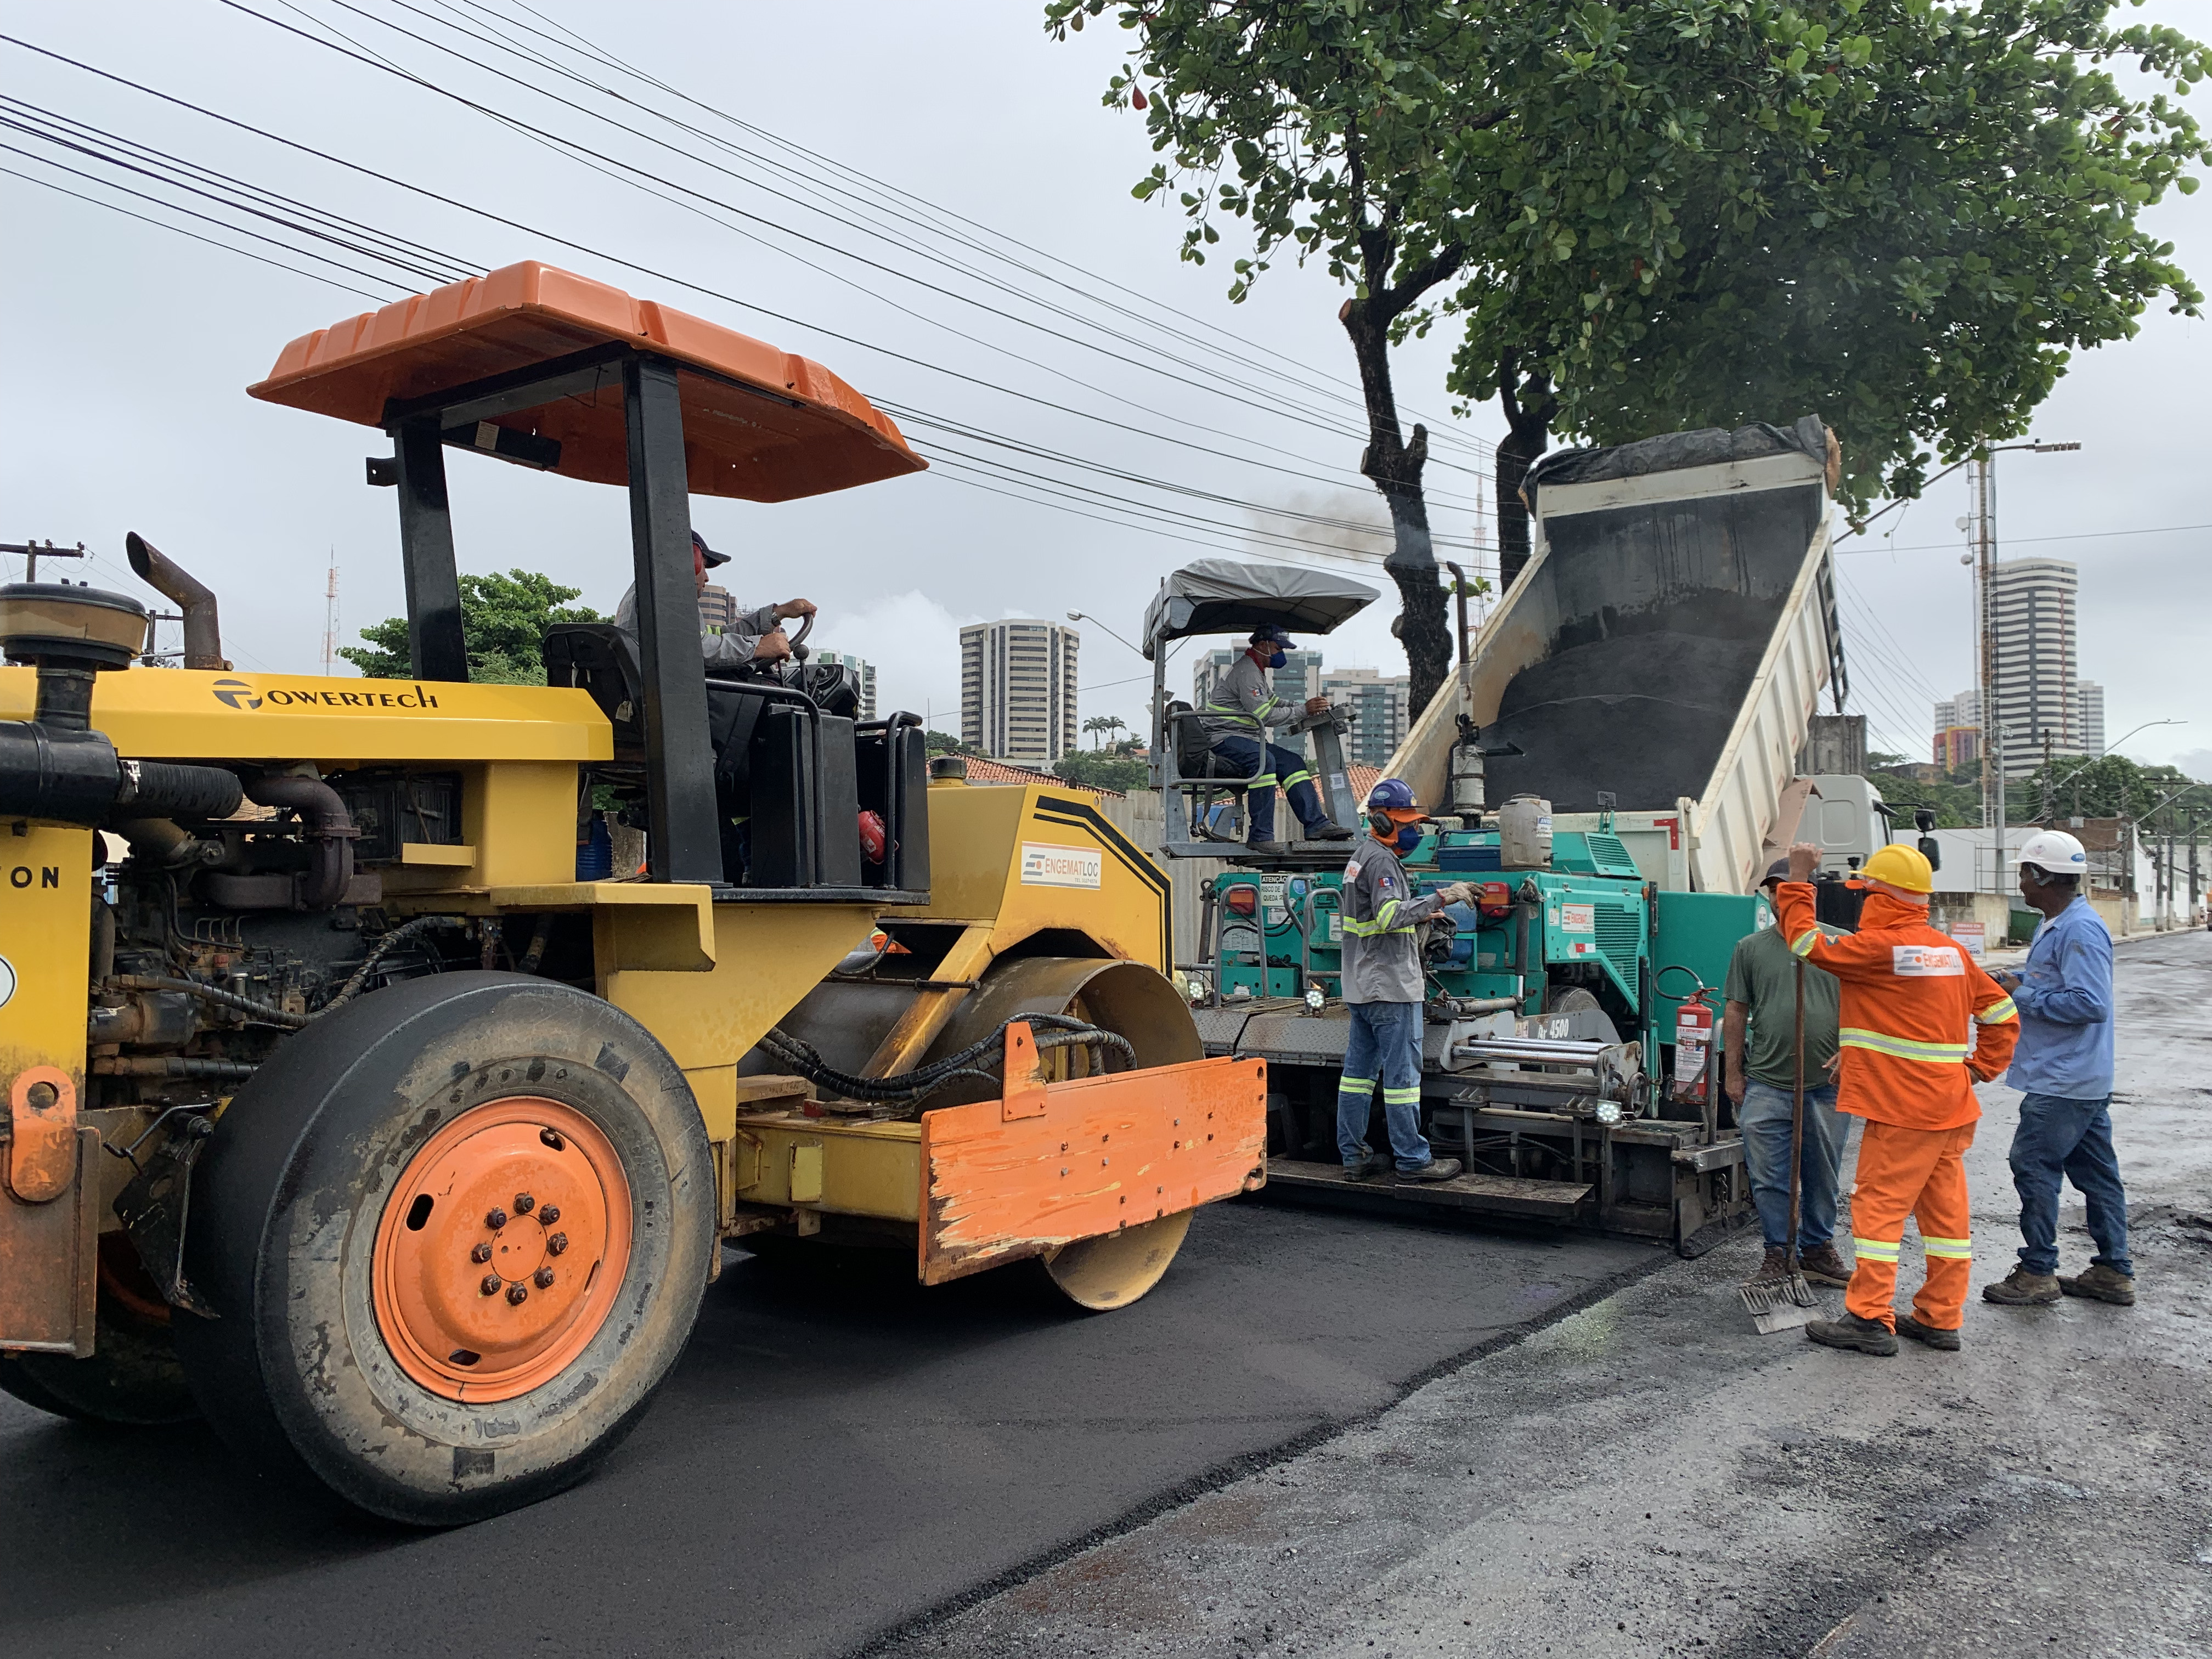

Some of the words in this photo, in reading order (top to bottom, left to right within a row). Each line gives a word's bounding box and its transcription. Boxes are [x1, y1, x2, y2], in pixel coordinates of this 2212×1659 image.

[0, 866, 59, 889] ON
[1045, 857, 1098, 877] ENGEMATLOC
[1550, 1018, 1569, 1039] 4500
